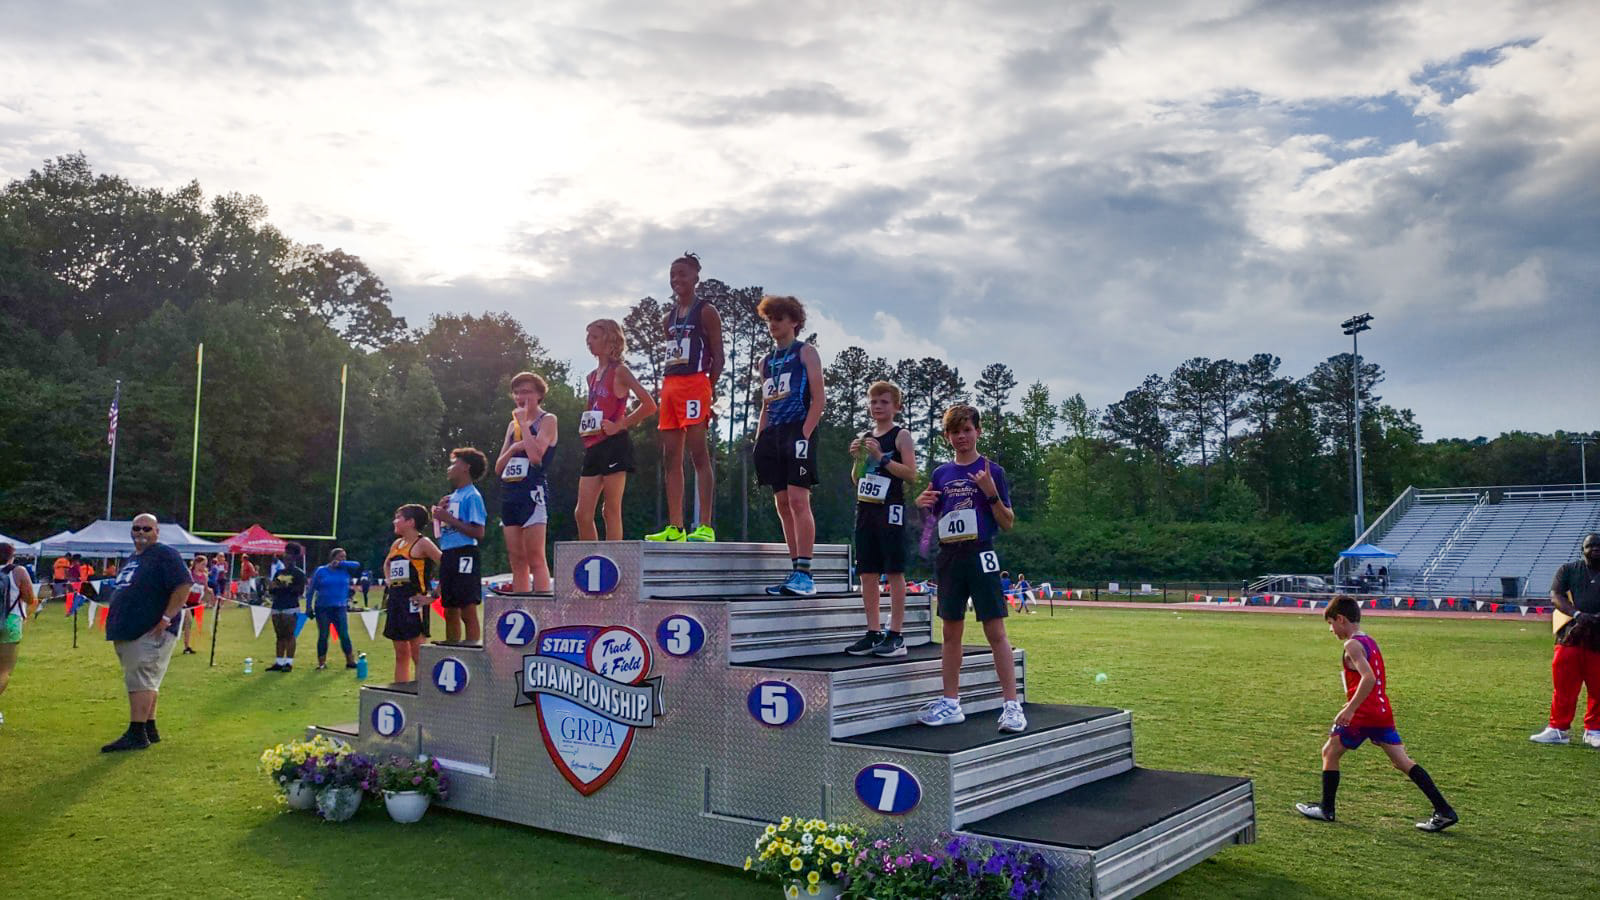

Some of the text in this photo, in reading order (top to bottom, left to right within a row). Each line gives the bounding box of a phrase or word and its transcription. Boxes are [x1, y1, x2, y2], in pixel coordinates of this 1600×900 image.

[768, 381, 785, 396] 22
[688, 401, 698, 417] 3
[798, 441, 807, 457] 2
[859, 481, 881, 496] 695
[893, 506, 901, 523] 5
[948, 519, 965, 534] 40
[462, 558, 471, 572] 7
[983, 553, 997, 571] 8
[584, 559, 601, 592] 1
[505, 612, 526, 645] 2
[667, 618, 691, 655] 3
[542, 637, 586, 654] STATE
[602, 637, 633, 657] Track
[600, 656, 642, 675] & Field
[438, 660, 457, 692] 4
[527, 661, 648, 721] CHAMPIONSHIP
[760, 685, 789, 725] 5
[377, 705, 397, 735] 6
[561, 716, 616, 745] GRPA
[873, 768, 900, 812] 7
